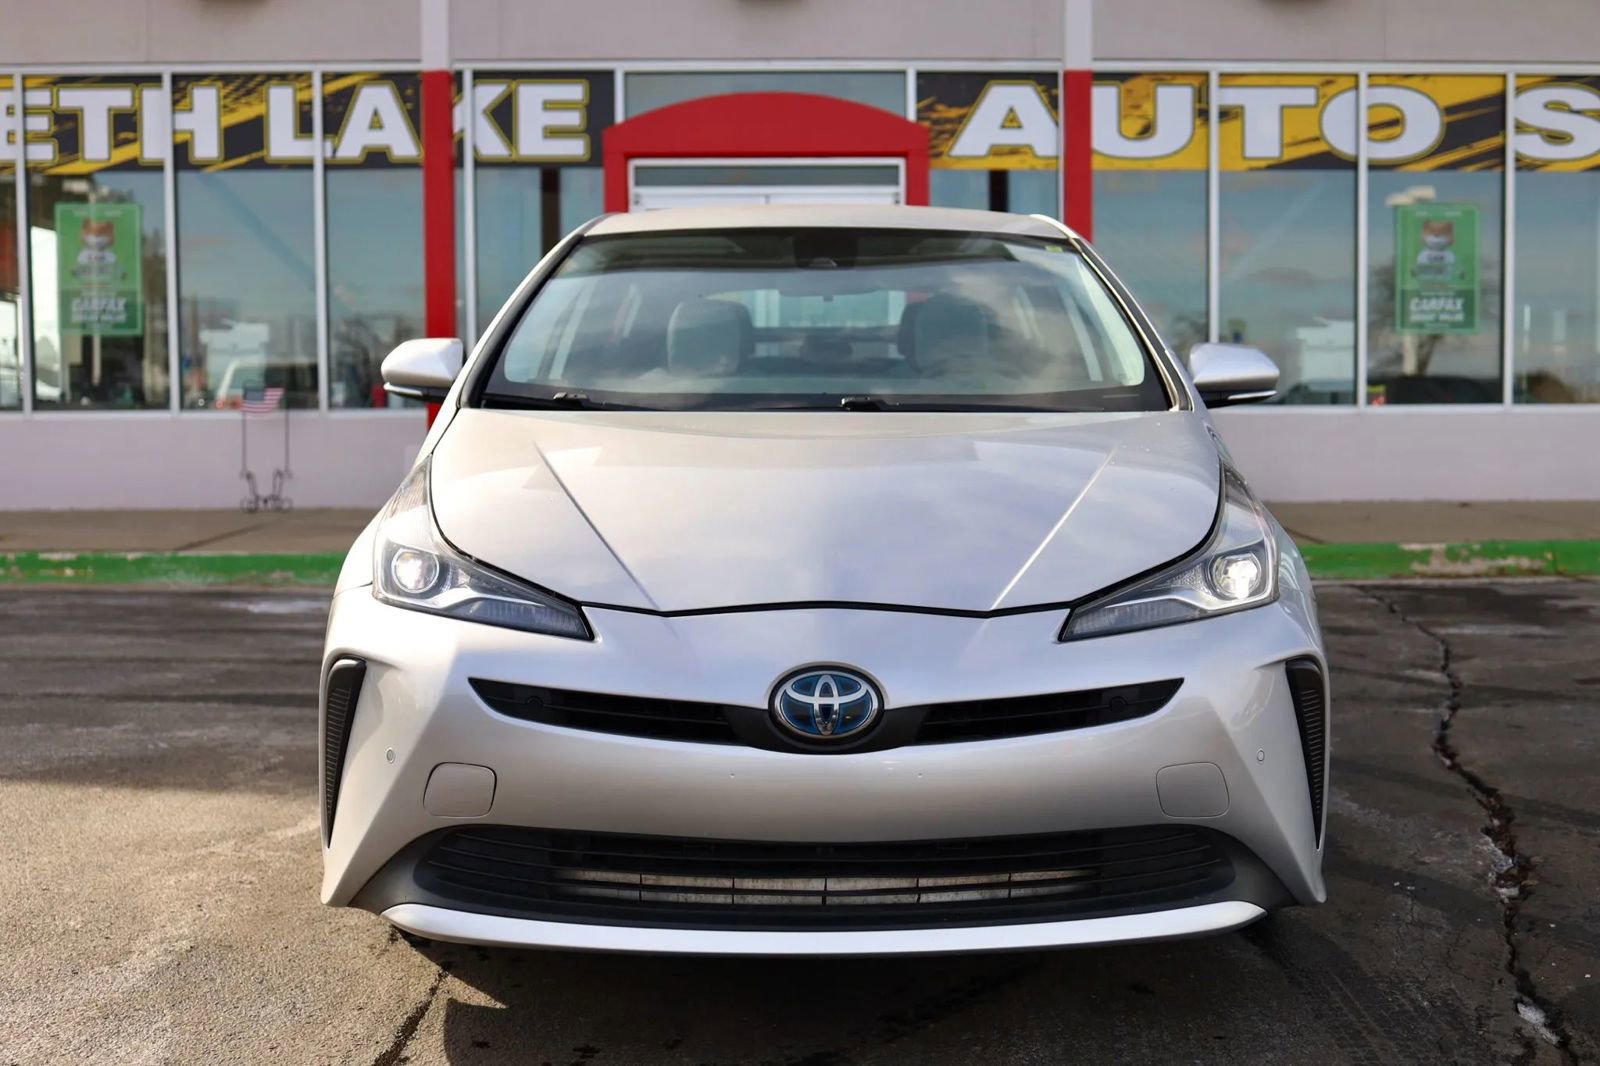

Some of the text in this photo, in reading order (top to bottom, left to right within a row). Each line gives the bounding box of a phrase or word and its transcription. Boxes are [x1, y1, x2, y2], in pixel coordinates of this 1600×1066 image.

[265, 80, 590, 163] LAKE
[948, 80, 1445, 165] AUTO
[1409, 297, 1465, 311] CARFAX
